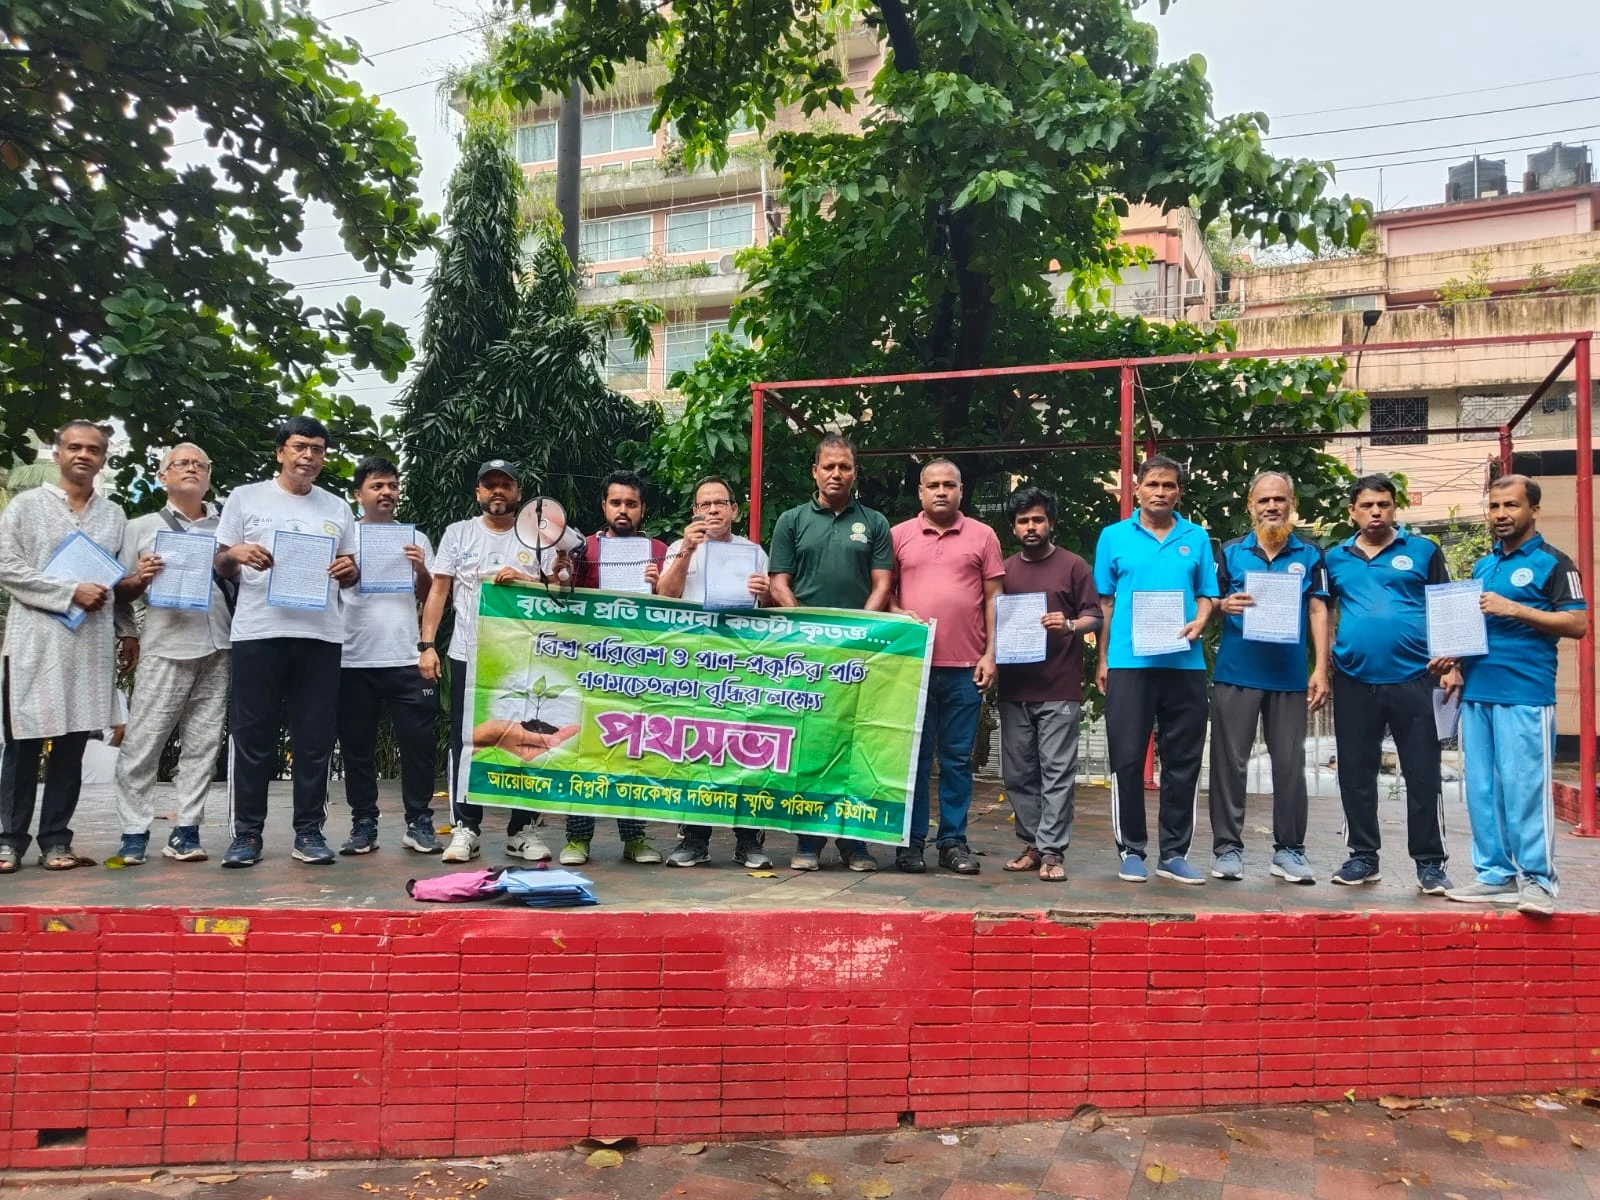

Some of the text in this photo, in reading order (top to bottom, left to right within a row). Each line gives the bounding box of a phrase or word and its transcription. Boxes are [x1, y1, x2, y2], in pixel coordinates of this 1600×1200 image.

[593, 599, 640, 620] প্রতি
[645, 606, 719, 628] আমরা
[726, 614, 794, 635] কতটা
[534, 632, 579, 658] বিশ্ব
[584, 636, 667, 667] পরিবেশ
[671, 648, 688, 666] ও
[828, 658, 868, 683] প্রতি
[577, 671, 825, 713] গণসচেতনতা বৃদ্ধির লক্ষ্যে
[595, 711, 796, 773] পথসভা
[488, 771, 553, 794] আয়োজনে
[569, 775, 610, 799] বিপ্লবী
[615, 781, 682, 805] তারকেশ্বর
[687, 785, 738, 810] দস্তিদার
[742, 790, 775, 817] স্মৃতি
[781, 794, 829, 821] পরিষদ,
[835, 798, 879, 823] চট্টগ্রাম
